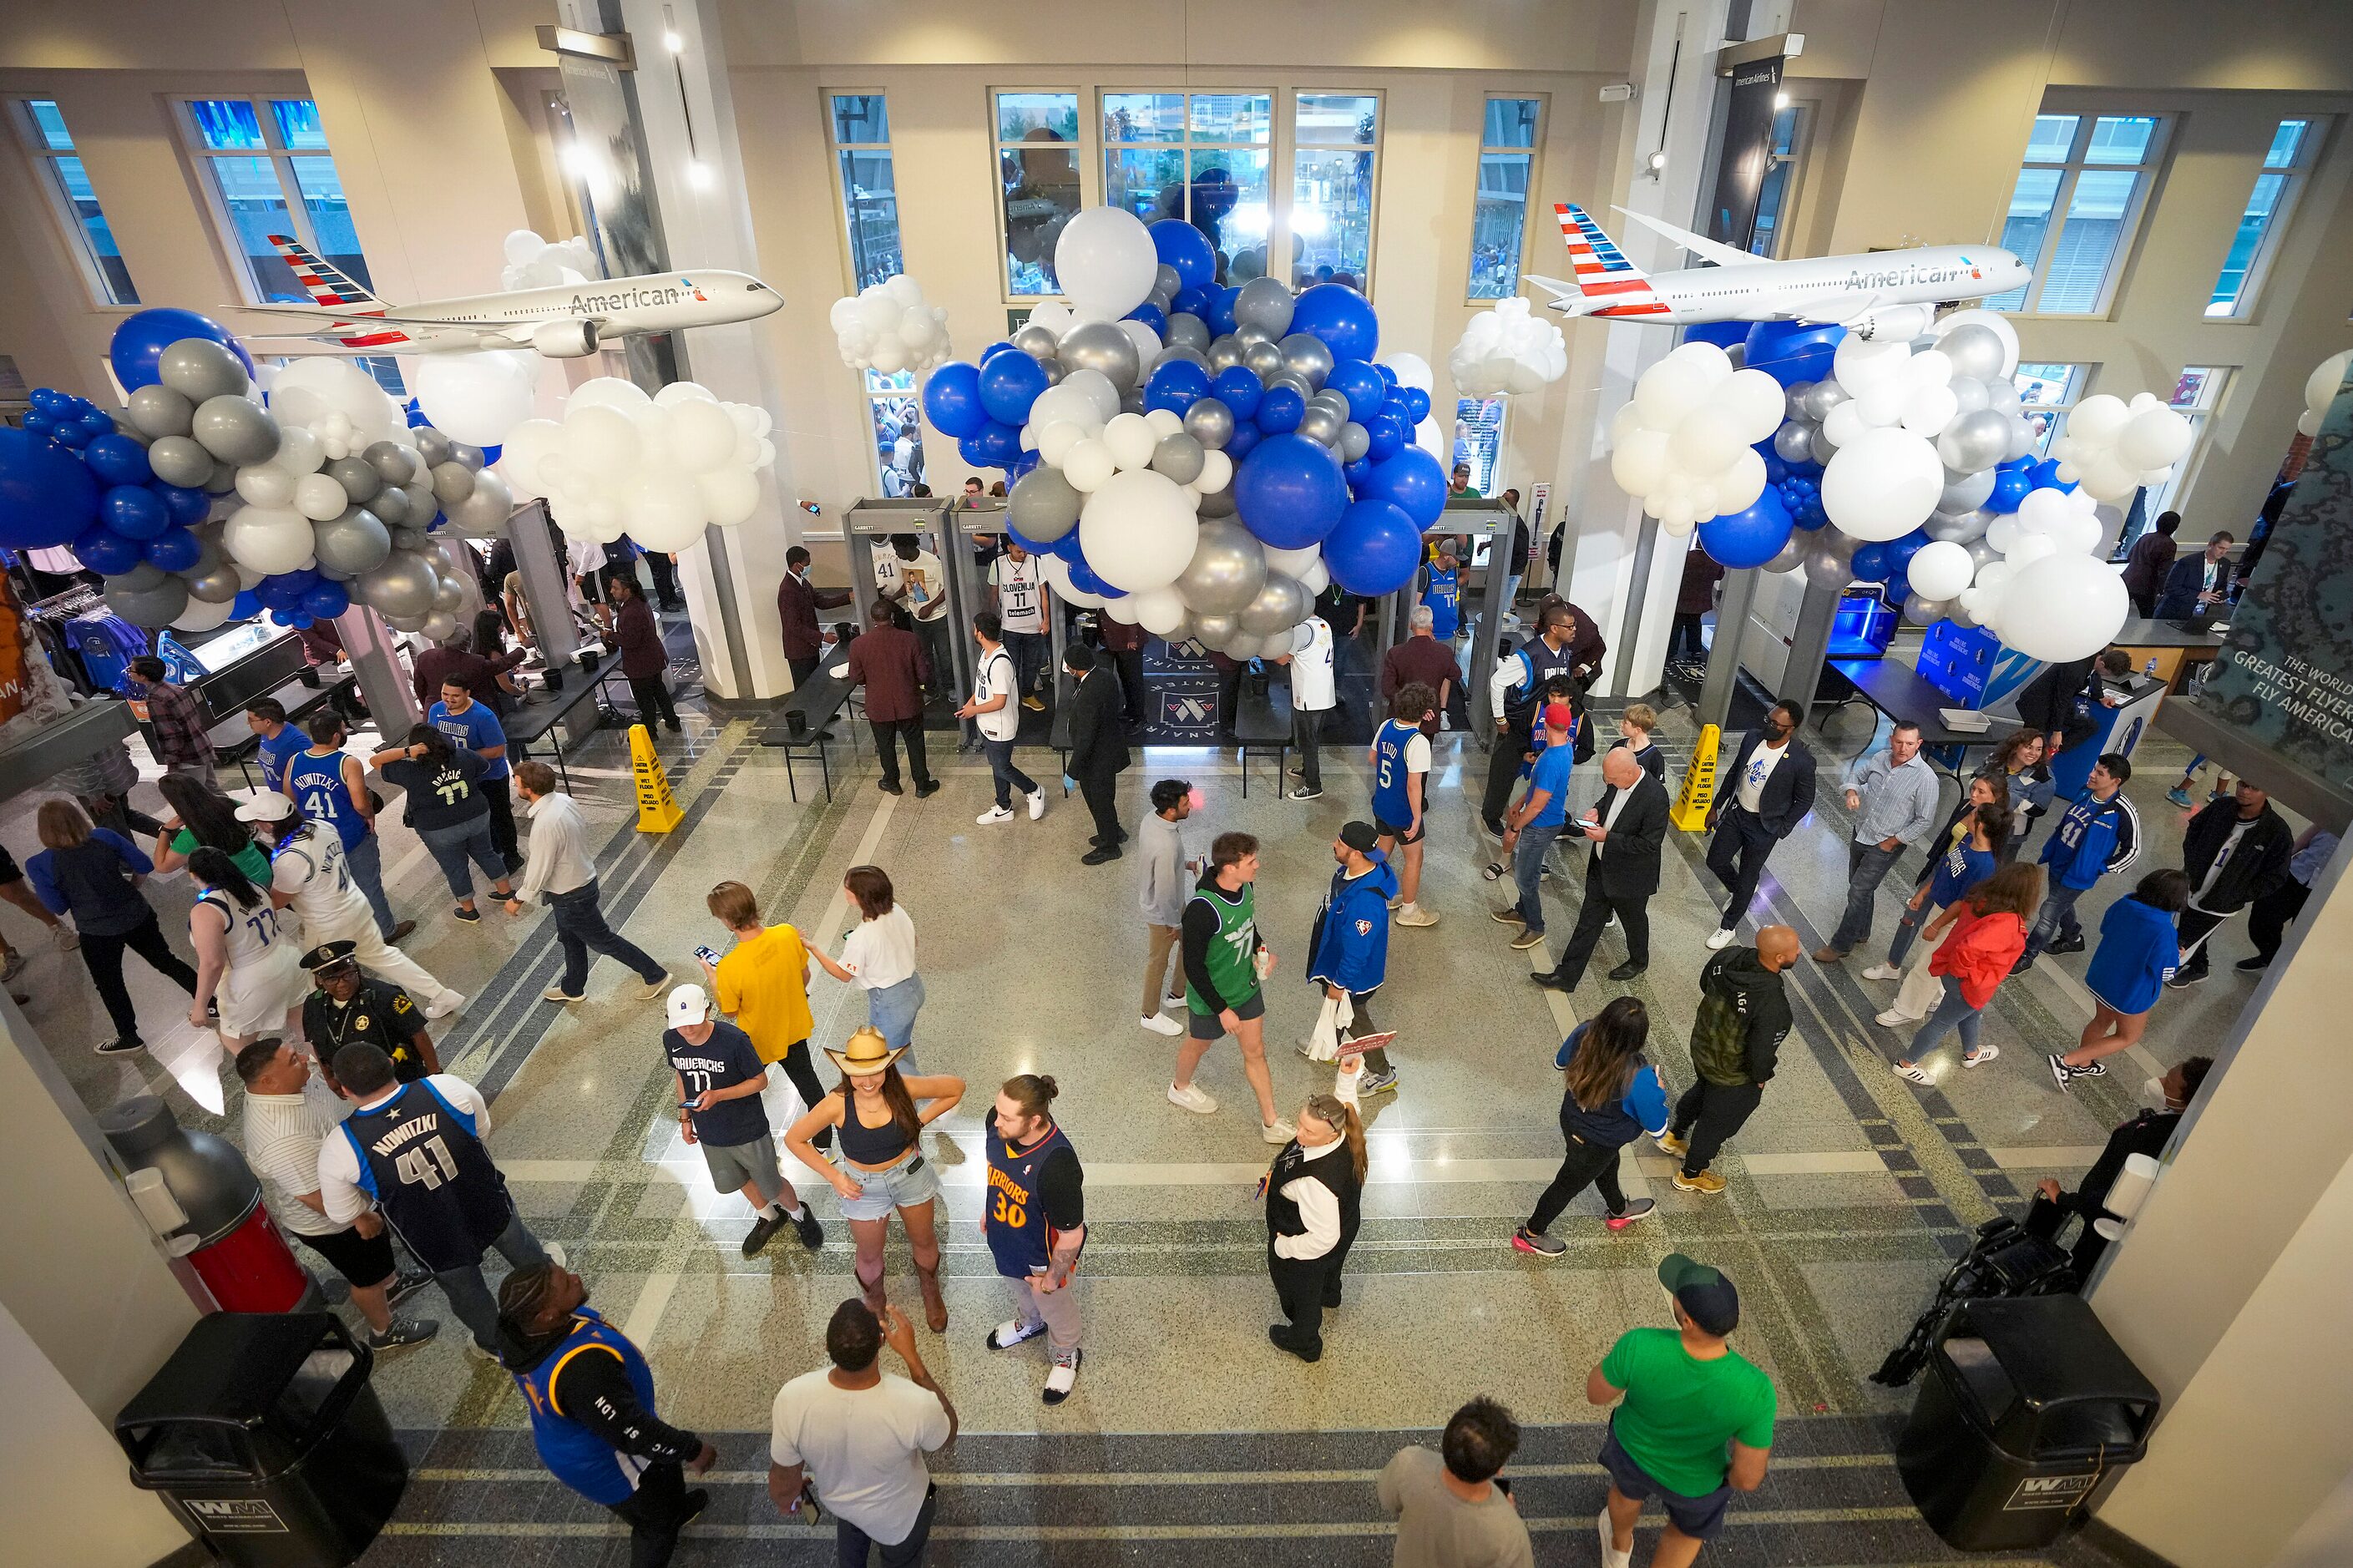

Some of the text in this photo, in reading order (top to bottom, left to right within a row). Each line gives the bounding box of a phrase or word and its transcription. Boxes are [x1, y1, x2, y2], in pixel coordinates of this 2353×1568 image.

[564, 64, 607, 80] American Airlines
[1735, 72, 1769, 87] American Airlines
[1845, 264, 1956, 291] American
[571, 286, 679, 315] American
[878, 563, 894, 578] 41
[1002, 582, 1035, 593] SLOVENIJA
[1014, 592, 1026, 607] 77
[1444, 594, 1455, 608] 77
[1009, 606, 1035, 616] telemach
[2234, 650, 2308, 694] GREATEST
[2284, 655, 2308, 674] THE
[2252, 680, 2280, 702] FLY
[437, 720, 469, 737] DALLAS
[1382, 741, 1398, 760] KIDD
[294, 772, 339, 792] NOWITZKI
[1379, 758, 1392, 789] 5
[436, 780, 469, 806] 77
[305, 792, 338, 818] 41
[2061, 821, 2082, 849] 41
[246, 908, 276, 947] 77
[671, 1056, 726, 1073] MAVERICKS
[686, 1070, 711, 1092] 77
[372, 1113, 438, 1157] NOWITZKI
[395, 1134, 458, 1191] 41
[987, 1166, 1030, 1205] ARRIORS
[993, 1191, 1027, 1228] 30
[595, 1395, 617, 1421] LDN
[623, 1425, 640, 1439] SF
